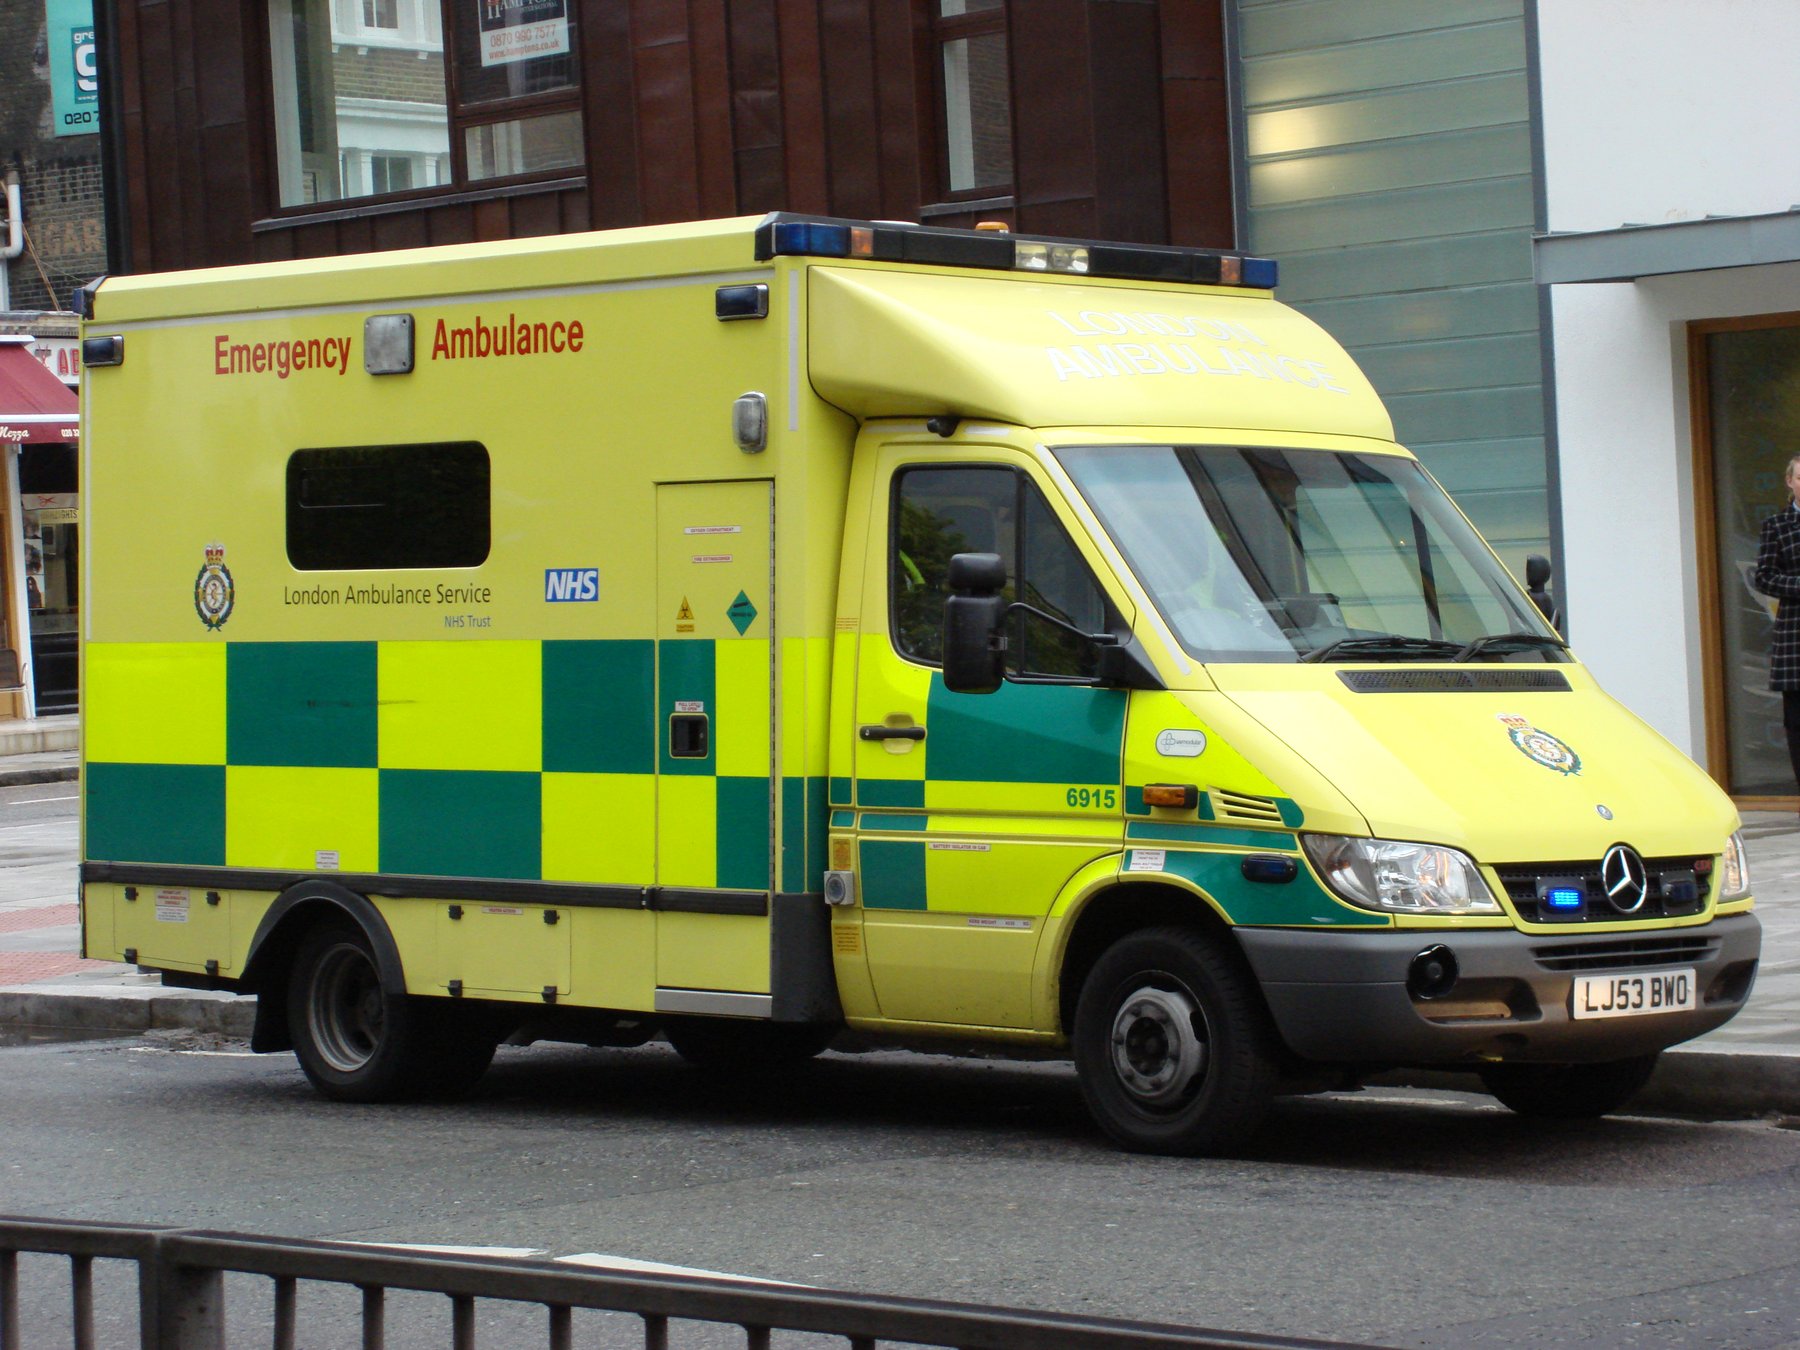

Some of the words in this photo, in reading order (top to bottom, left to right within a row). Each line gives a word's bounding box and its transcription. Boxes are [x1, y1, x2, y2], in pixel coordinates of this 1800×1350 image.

[490, 32, 513, 48] 0870
[534, 23, 557, 40] 7577
[64, 111, 92, 125] 020
[1044, 310, 1268, 347] LONDON
[214, 334, 352, 379] Emergency
[431, 313, 584, 360] Ambulance
[1046, 343, 1351, 395] AMBULANCE
[284, 583, 340, 605] London
[344, 583, 432, 605] Ambulance
[436, 582, 492, 604] Service
[547, 570, 598, 600] NHS
[444, 615, 465, 628] NHS
[468, 614, 491, 628] Trust
[1066, 787, 1116, 809] 6915
[1585, 978, 1644, 1012] LJ53
[1650, 974, 1688, 1008] BWO
